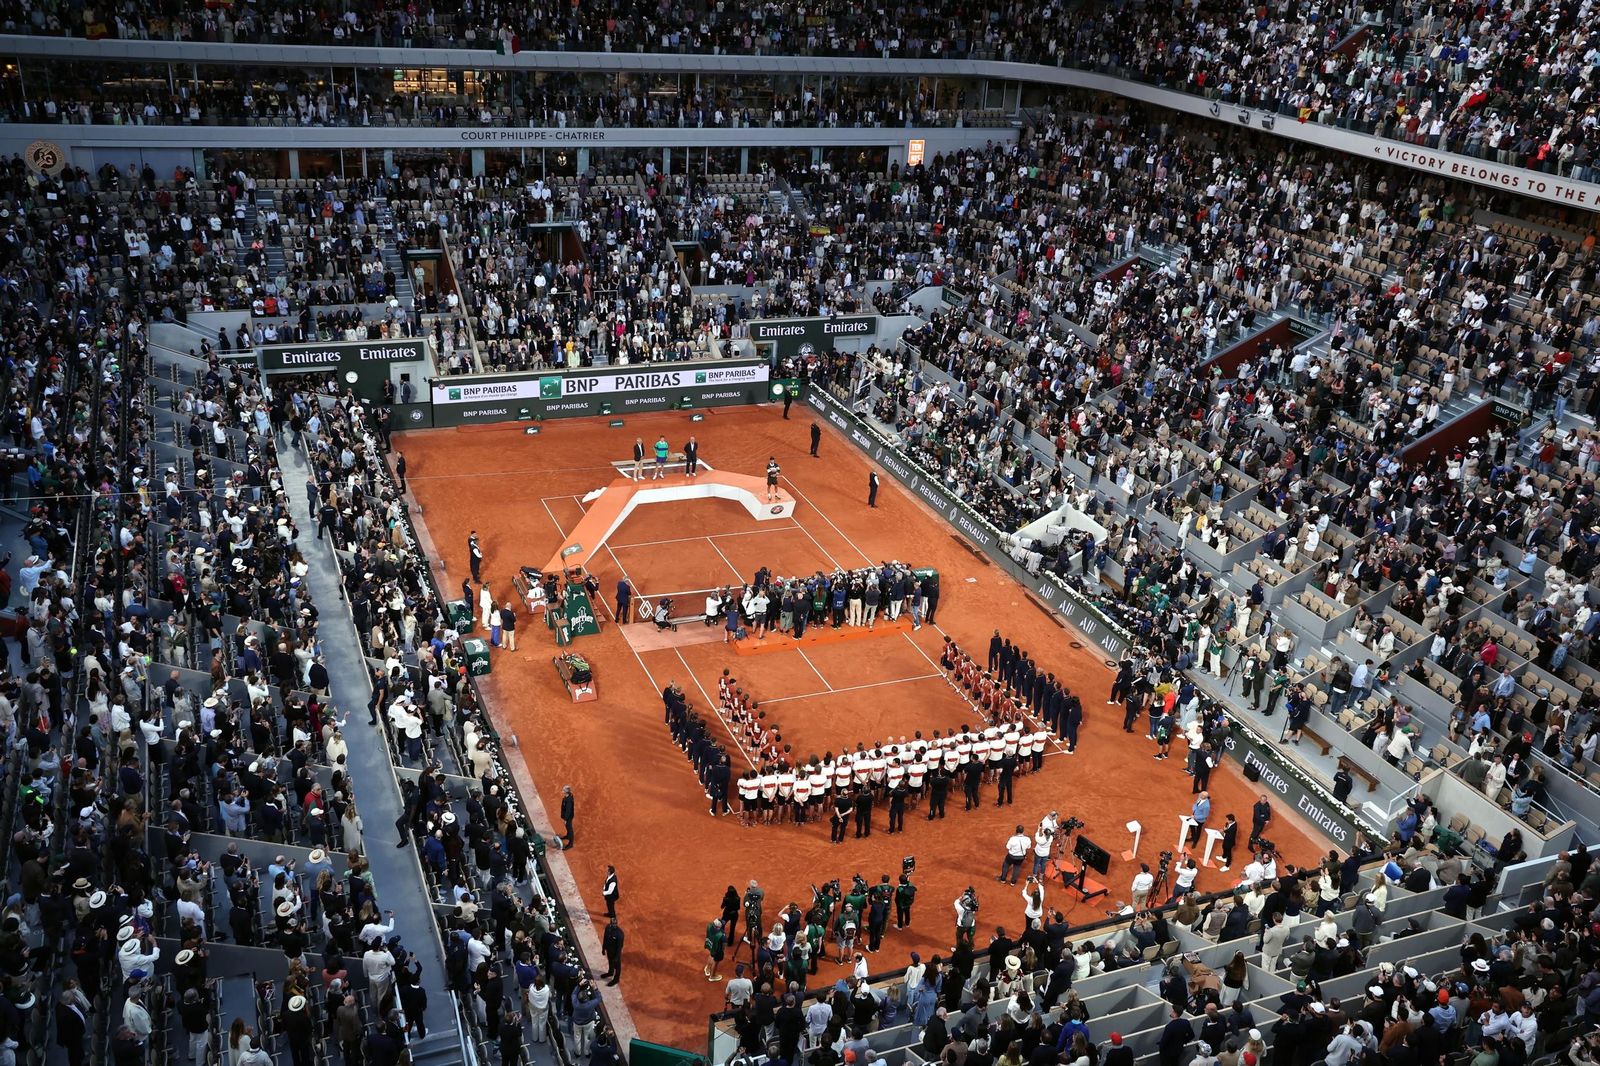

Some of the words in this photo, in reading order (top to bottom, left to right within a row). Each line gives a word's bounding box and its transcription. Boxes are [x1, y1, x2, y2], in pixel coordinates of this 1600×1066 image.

[461, 131, 498, 140] COURT
[500, 131, 547, 140] PHILIPPE
[555, 131, 605, 140] CHATRIER
[1387, 146, 1446, 169] VICTORY
[1451, 163, 1520, 187] BELONGS
[1527, 179, 1546, 193] TO
[1555, 186, 1586, 202] THE
[760, 325, 805, 337] Emirates
[823, 321, 868, 334] Emirates
[282, 351, 341, 364] Emirates
[359, 347, 417, 360] Emirates
[708, 371, 724, 379] BNP
[725, 369, 756, 378] PARIBAS
[565, 378, 599, 394] BNP
[615, 372, 681, 390] PARIBAS
[463, 387, 481, 396] BNP
[482, 384, 517, 394] PARIBAS
[715, 391, 741, 399] PARIBAS
[561, 402, 589, 410] PARIBAS
[639, 396, 666, 405] PARIBAS
[463, 410, 478, 418] BNP
[478, 408, 507, 417] PARIBAS
[883, 455, 909, 479] RENAULT
[919, 484, 948, 510] RENAULT
[958, 517, 990, 545] RENAULT
[1244, 750, 1290, 794] Emirates
[1297, 794, 1348, 842] Emirates
